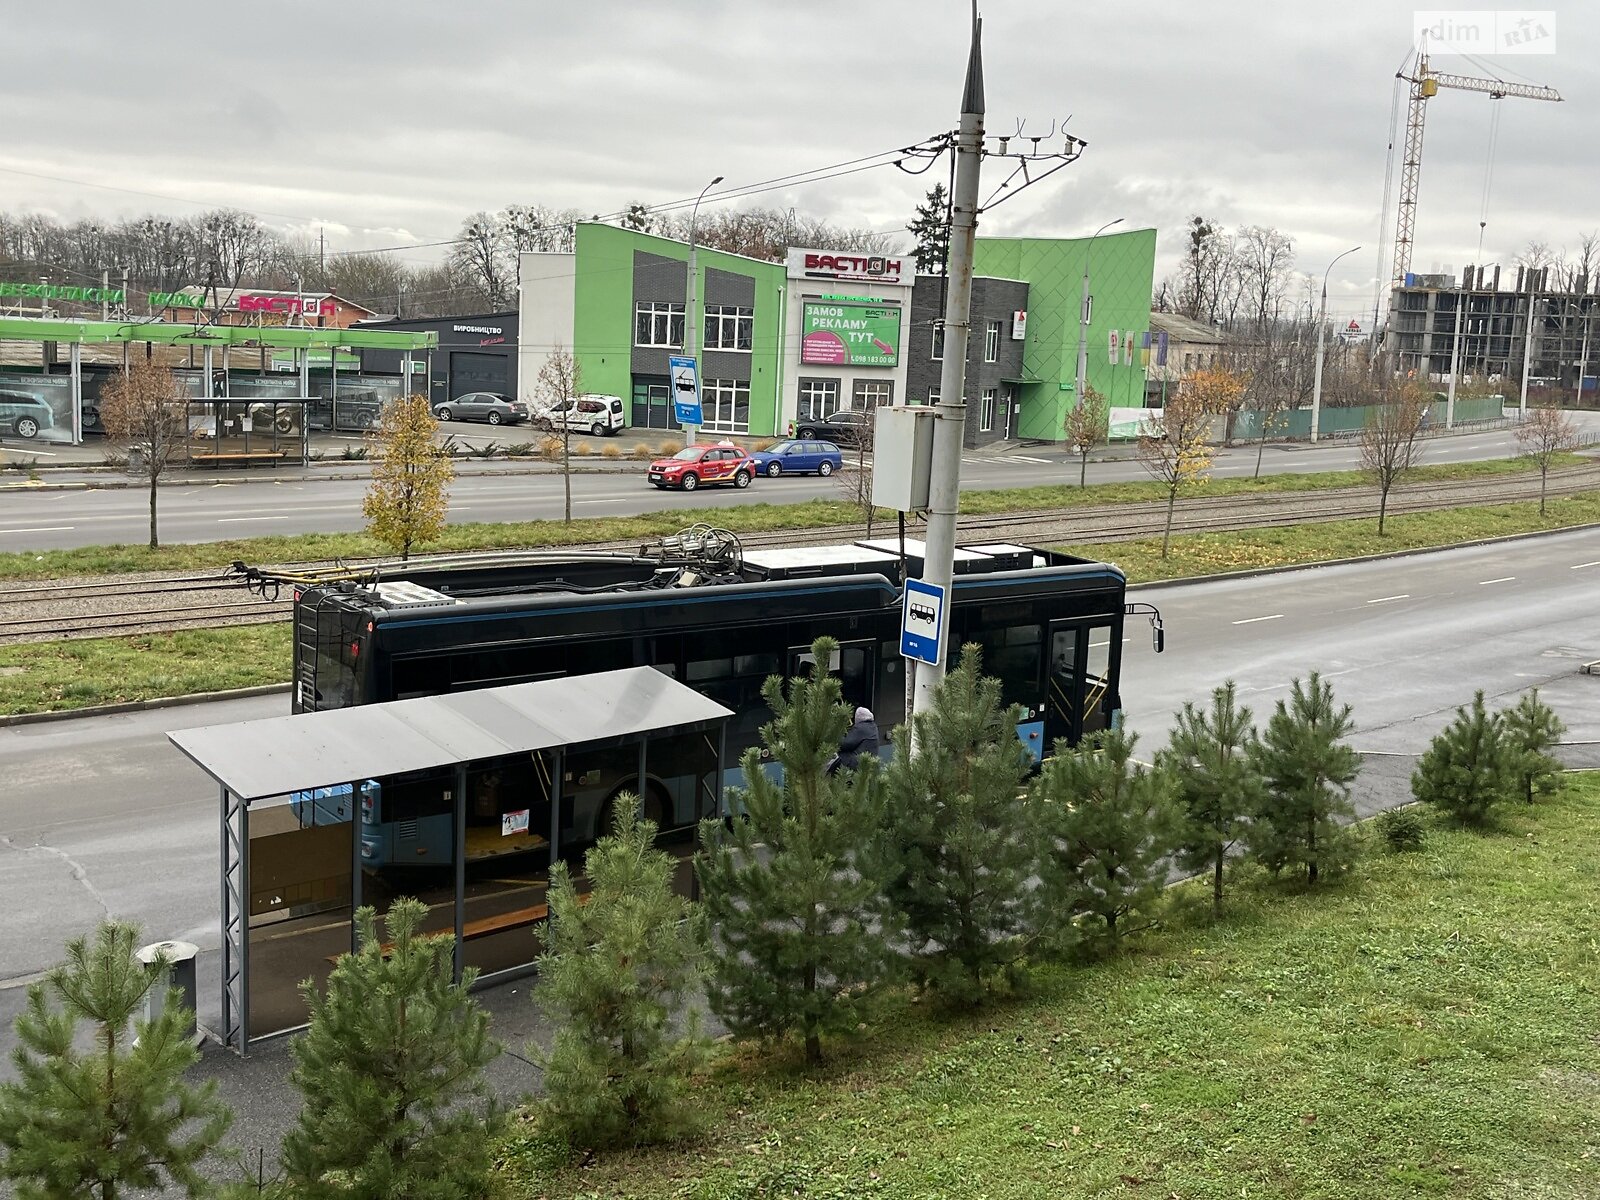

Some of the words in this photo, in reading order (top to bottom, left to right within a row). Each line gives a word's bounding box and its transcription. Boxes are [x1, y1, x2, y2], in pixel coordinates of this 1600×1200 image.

[807, 307, 844, 317] ЗАМОВ
[812, 318, 867, 329] РЕКЛАМУ
[453, 325, 502, 335] ВИРОБНИЦТВО
[848, 331, 874, 343] ТУТ
